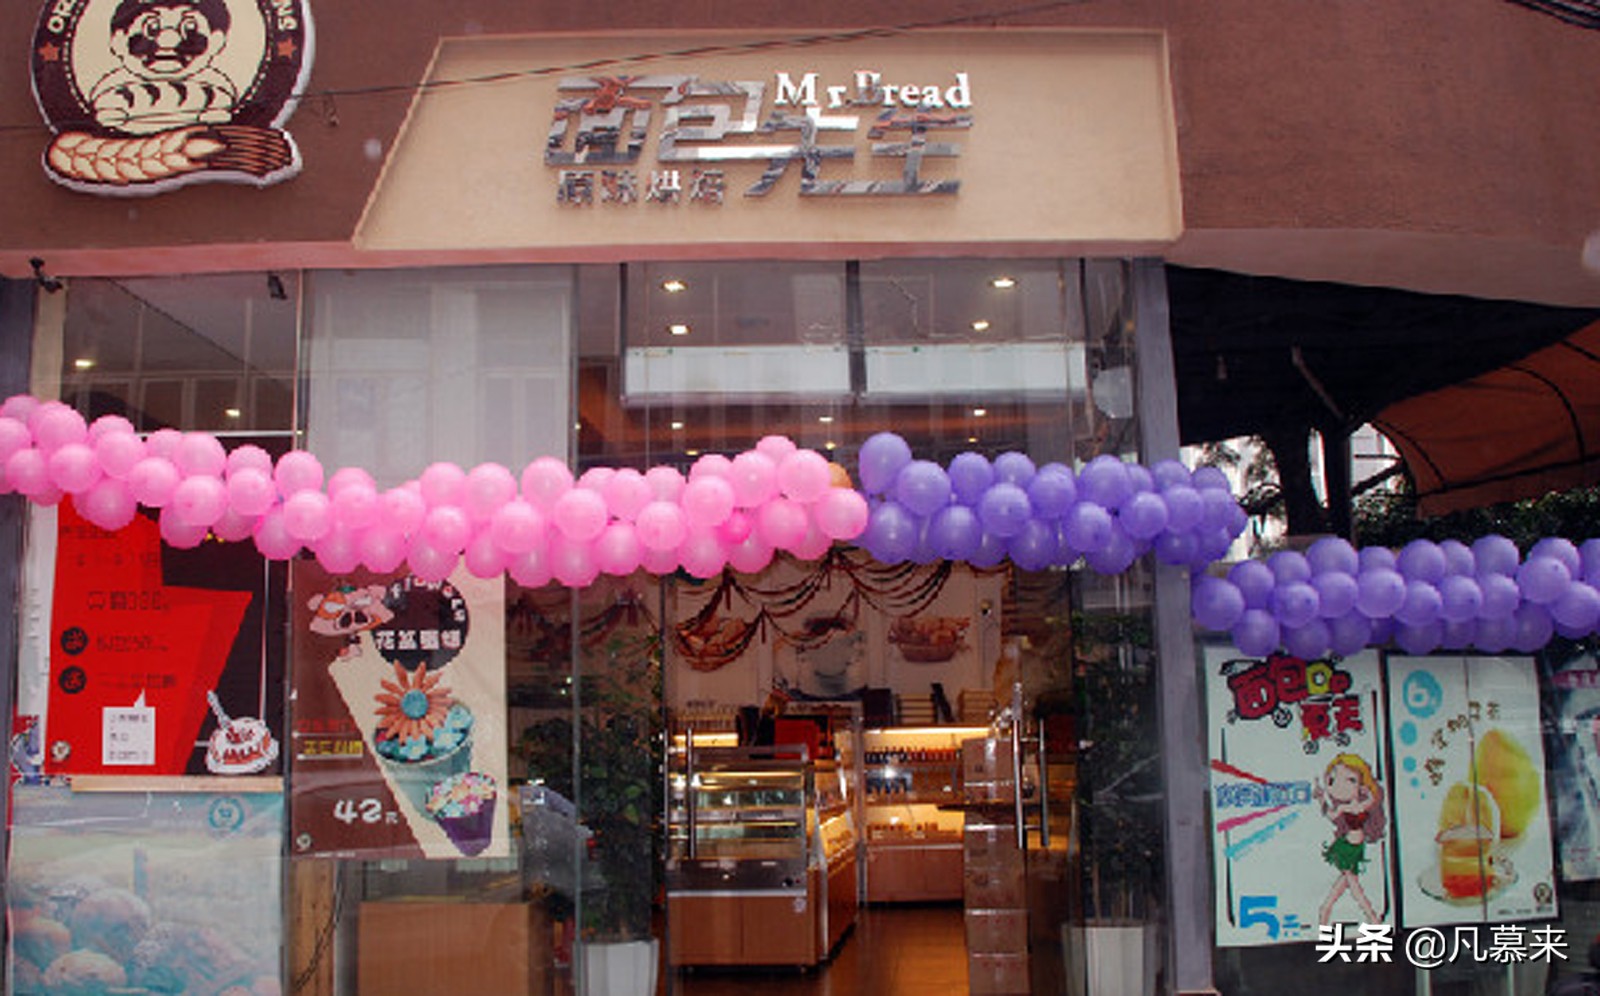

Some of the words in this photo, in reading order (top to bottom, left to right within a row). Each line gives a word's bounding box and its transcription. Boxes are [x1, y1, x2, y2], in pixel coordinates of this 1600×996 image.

[543, 75, 973, 198] 面包先生
[556, 169, 726, 206] 原味烘焙
